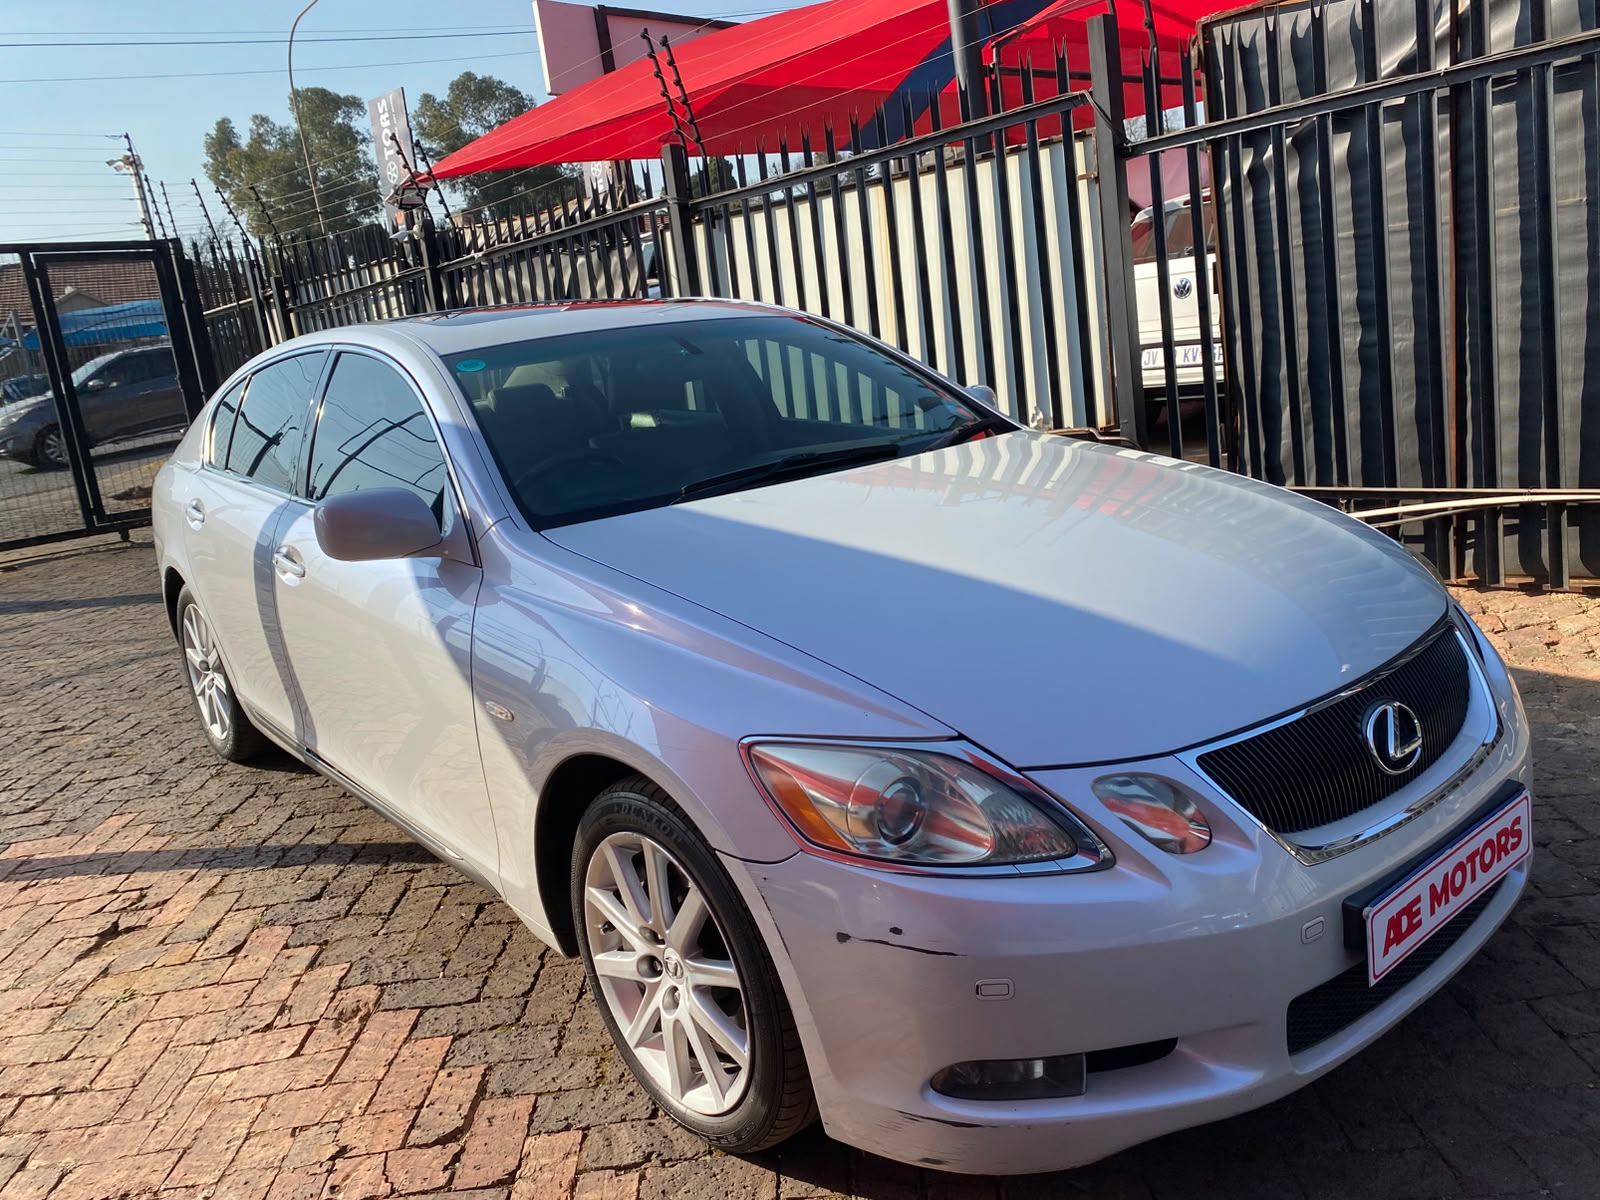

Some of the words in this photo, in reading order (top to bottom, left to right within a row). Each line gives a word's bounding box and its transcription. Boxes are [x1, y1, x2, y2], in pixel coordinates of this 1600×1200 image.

[1183, 346, 1199, 363] KV
[1382, 894, 1423, 958] ADE
[1429, 815, 1523, 917] MOTORS
